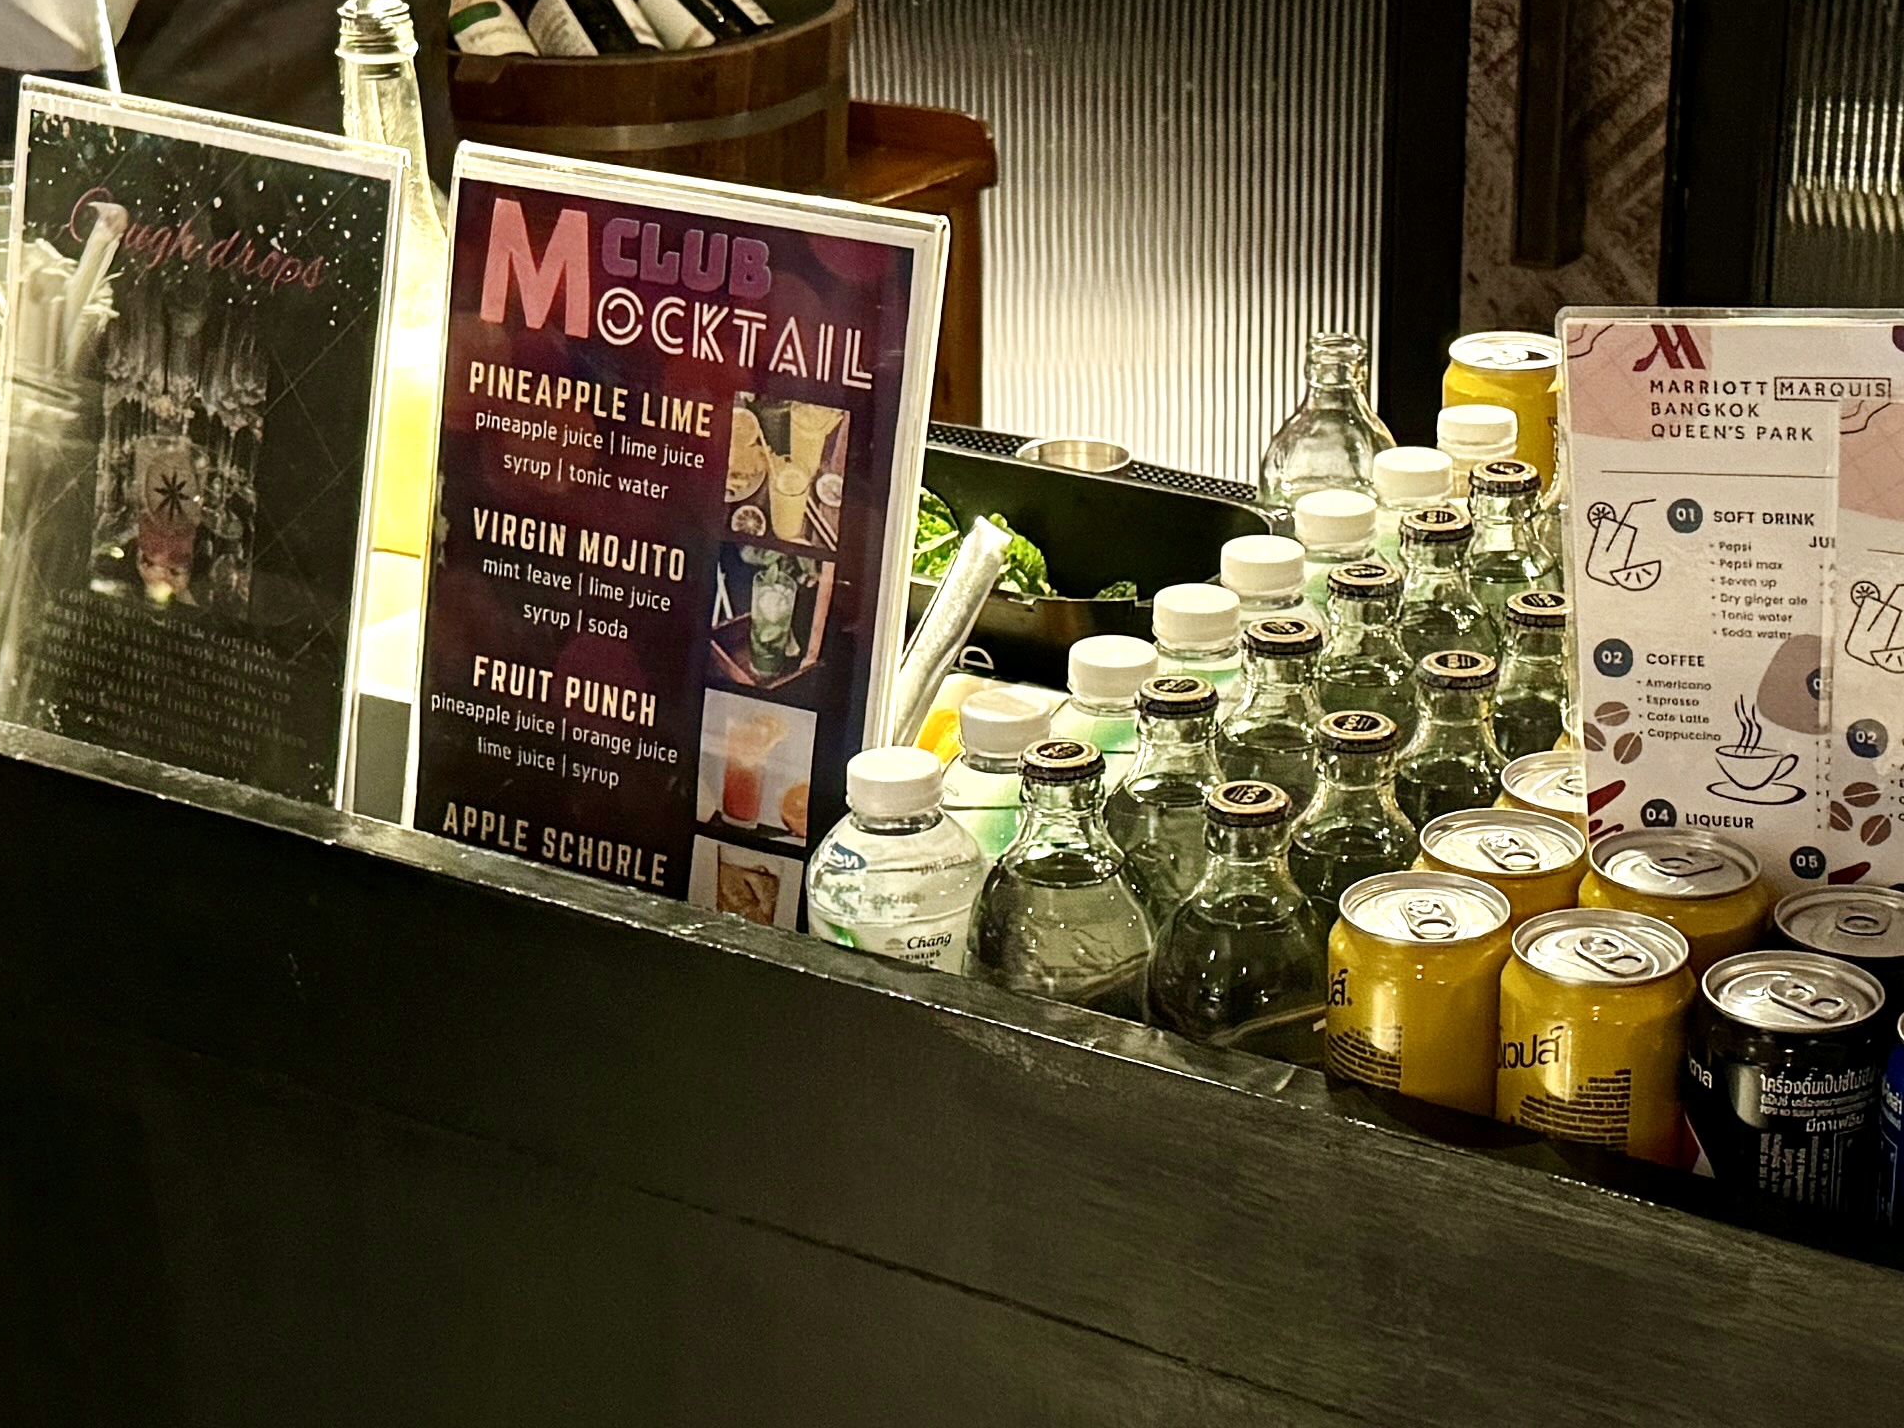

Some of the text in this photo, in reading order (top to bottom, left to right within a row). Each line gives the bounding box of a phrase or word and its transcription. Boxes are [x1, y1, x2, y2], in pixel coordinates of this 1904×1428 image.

[70, 187, 198, 269] Cugh
[602, 218, 771, 300] CLUB
[1650, 380, 1887, 397] MARRIOTT MARQUIS
[469, 361, 714, 438] PINEAPPLE LIME
[1651, 403, 1760, 418] BANGKOK
[475, 410, 705, 468] pineapple juice lime juice
[1651, 424, 1814, 442] QUEEN'S PARK
[504, 455, 669, 499] syrup tonic water
[1676, 507, 1815, 527] 01 SOFT DRINK
[473, 507, 685, 581] VIRGIN MOJITO
[1719, 541, 1752, 553] Pepsi
[1808, 536, 1835, 548] JUI
[1720, 559, 1783, 571] Pepsi max
[484, 558, 671, 611] mint leave lime juice
[1761, 579, 1777, 589] up
[523, 604, 628, 639] syrup soda
[1602, 652, 1705, 667] 02 COFFEE
[474, 655, 656, 727] FRUIT PUNCH
[1646, 679, 1712, 690] Americano
[1646, 696, 1699, 707] Espresso
[1648, 712, 1709, 724] Cafe Latte
[431, 693, 678, 764] pineapple juice orange juice
[1648, 729, 1721, 742] Cappuccino
[1856, 730, 1877, 745] 02
[478, 737, 619, 790] lime juice syrup
[1646, 808, 1754, 828] 04 LIQUEUR
[443, 802, 668, 887] APPLE SCHORLE
[1796, 855, 1818, 867] 05
[907, 932, 952, 950] Chang
